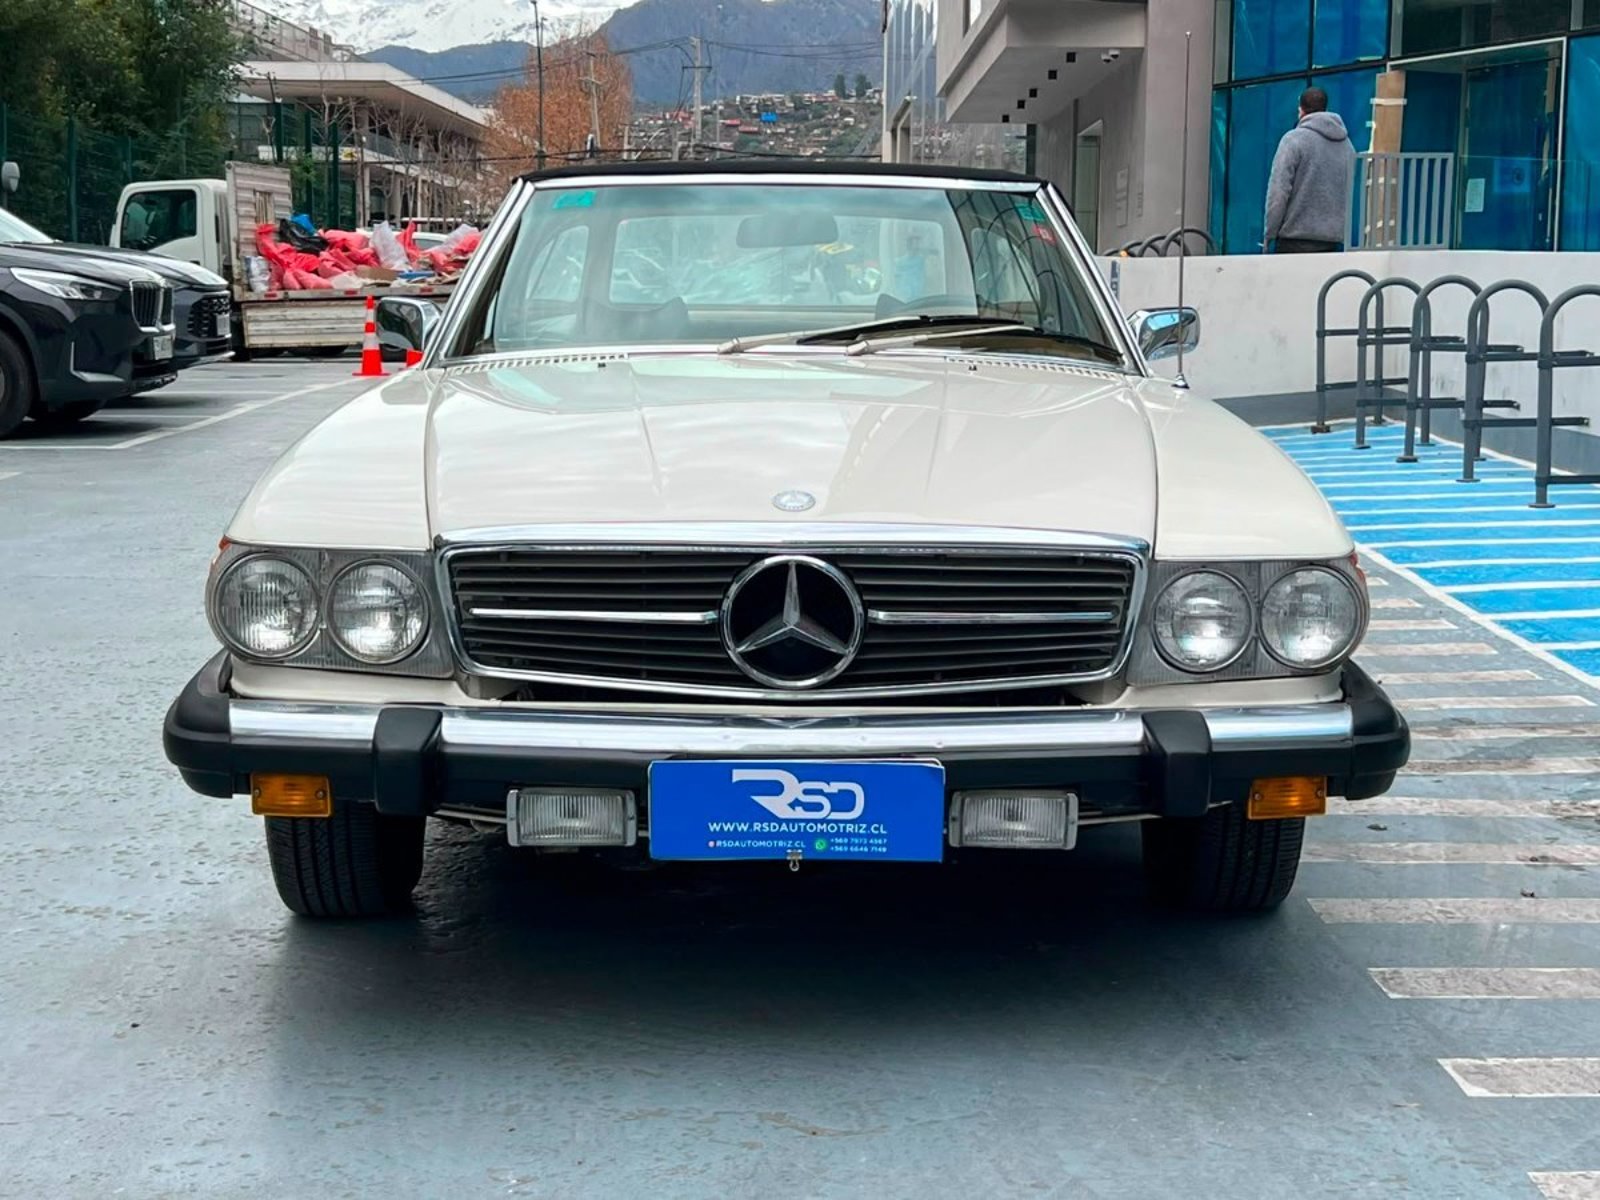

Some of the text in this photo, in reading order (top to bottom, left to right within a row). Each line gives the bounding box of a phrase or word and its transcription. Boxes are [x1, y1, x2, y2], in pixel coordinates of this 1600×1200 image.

[731, 769, 865, 820] RSD
[708, 822, 888, 835] WWW.RSDAUTOMOTRIZ.CL
[715, 840, 807, 849] RSDAUTOMOTRIZ.CL
